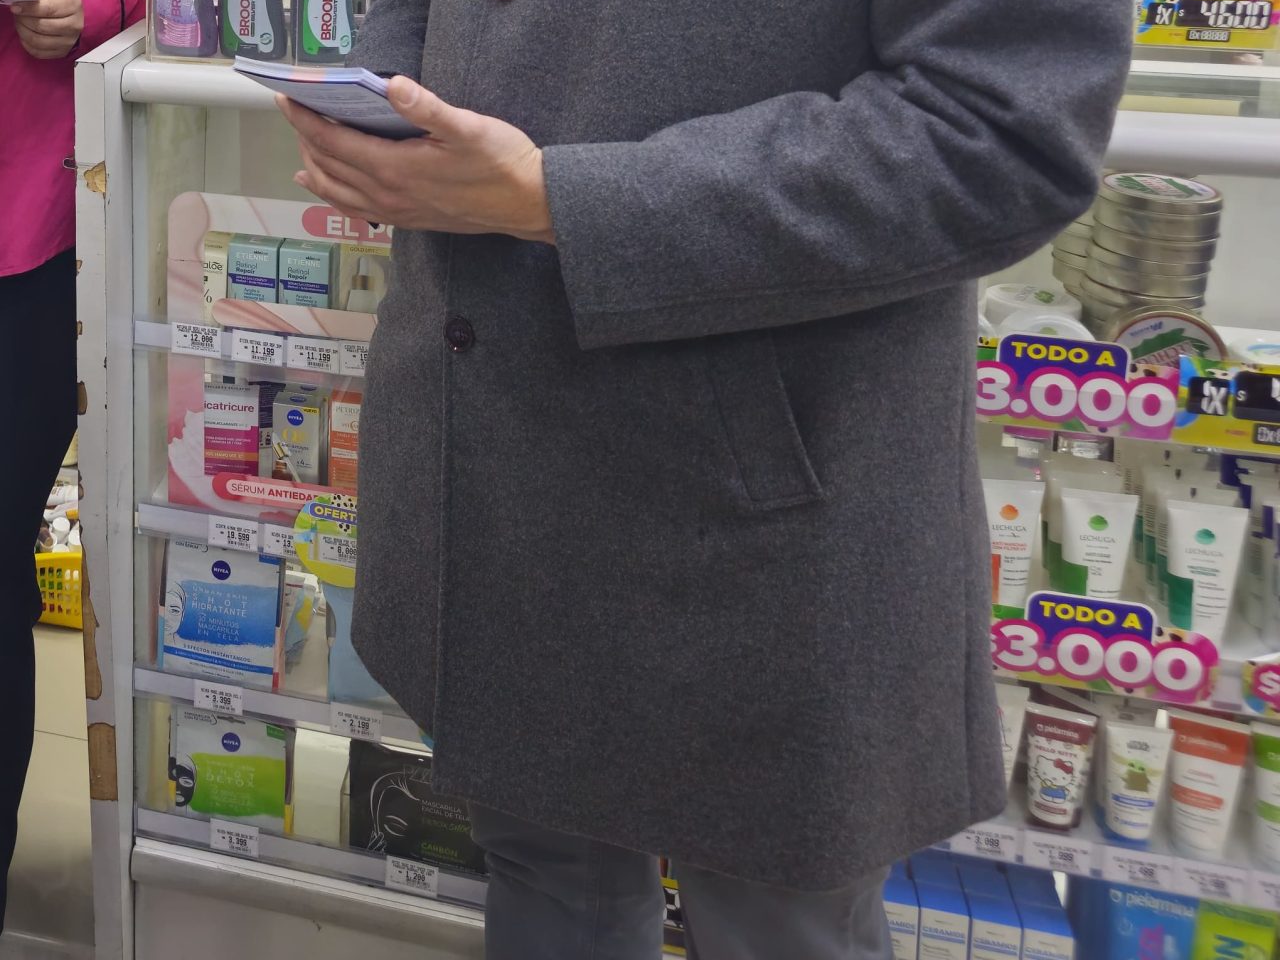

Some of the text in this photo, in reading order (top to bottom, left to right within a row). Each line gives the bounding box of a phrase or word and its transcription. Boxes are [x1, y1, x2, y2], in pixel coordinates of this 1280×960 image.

[326, 215, 359, 237] EL
[236, 251, 270, 262] ETIENNE
[287, 257, 321, 268] ETIENNE
[236, 260, 258, 270] Retinol
[236, 268, 255, 276] Repair
[287, 267, 310, 276] Retinol
[287, 274, 307, 282] Repair
[251, 345, 275, 357] 11.199
[1011, 341, 1116, 367] TODO A
[306, 352, 331, 363] 11.199
[204, 400, 255, 413] icatricure
[231, 483, 265, 496] SÉRUM
[314, 505, 357, 520] OFERT
[213, 566, 230, 574] NIVEA
[191, 601, 248, 618] HIDRATANTE
[1039, 600, 1143, 631] TODO A
[421, 798, 462, 814] MASCARILLA
